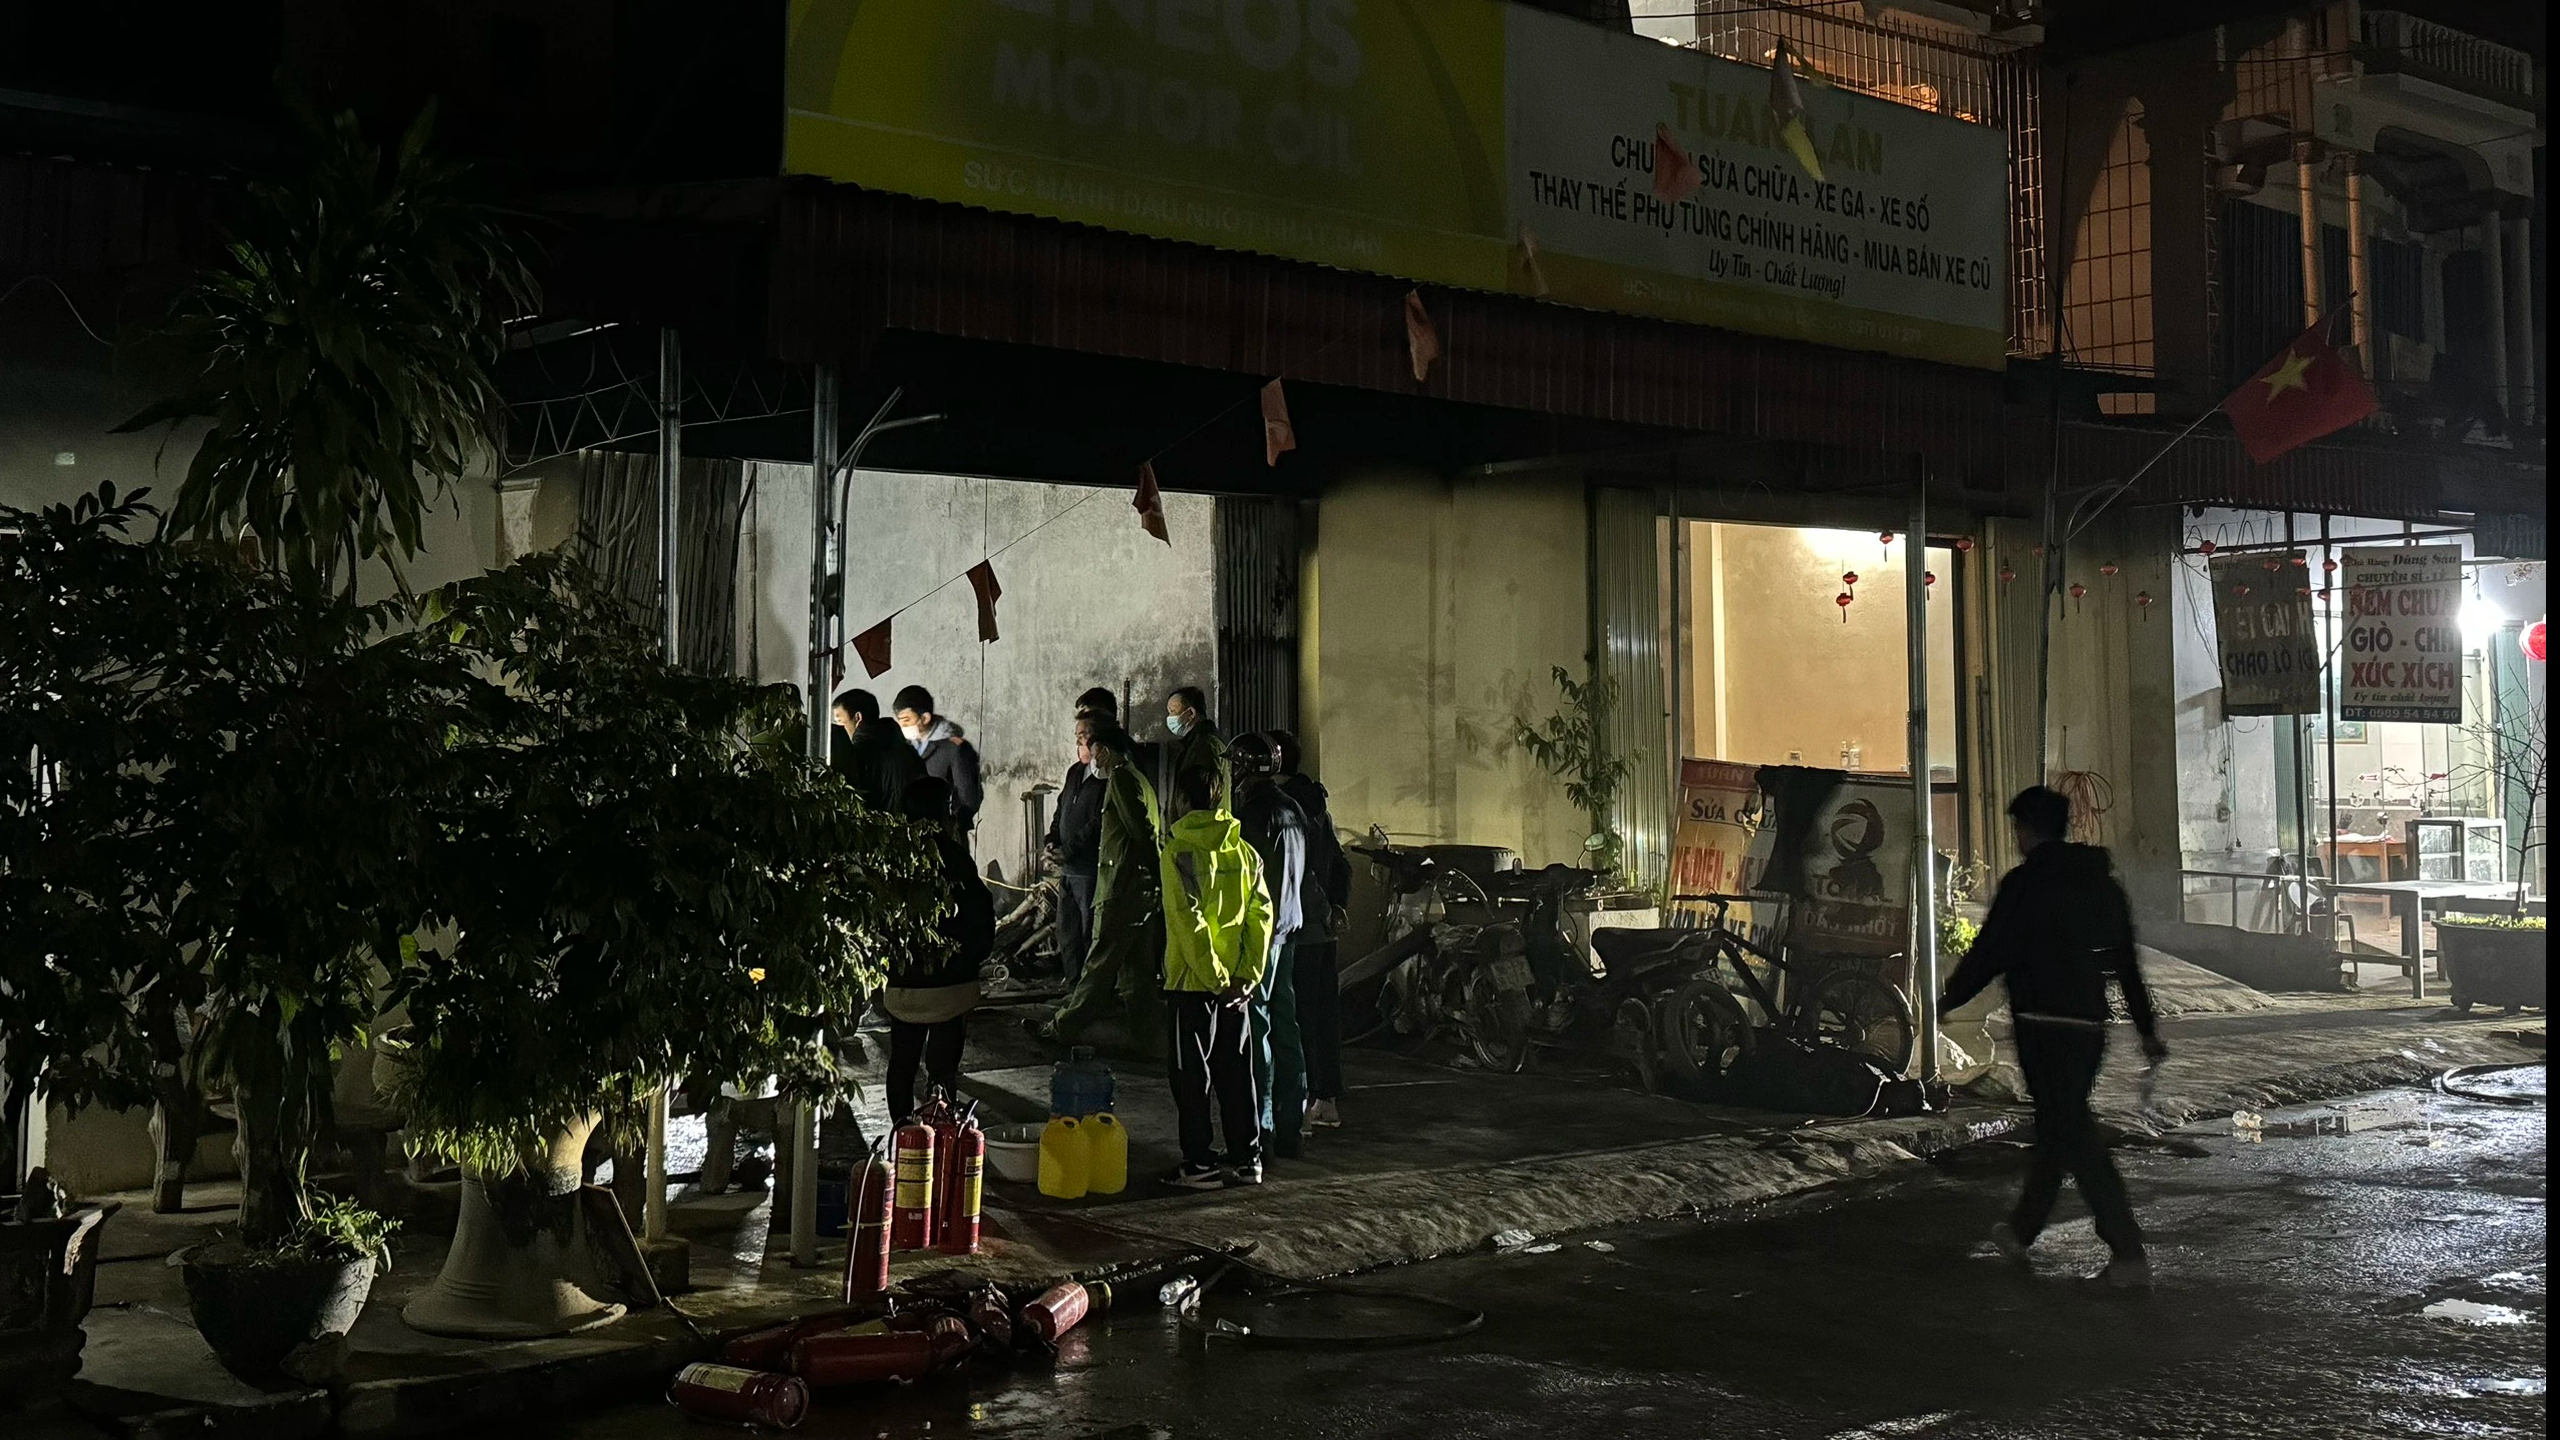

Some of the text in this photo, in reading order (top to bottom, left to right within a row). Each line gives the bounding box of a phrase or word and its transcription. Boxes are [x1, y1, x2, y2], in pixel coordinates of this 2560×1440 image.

[991, 40, 1364, 177] MOTOR OIL
[1699, 149, 1739, 192] SỬA
[1744, 164, 1800, 206] CHỮA
[1815, 181, 1836, 213] XE
[1841, 187, 1866, 220] GA
[1880, 197, 1903, 228] XE
[1905, 193, 1931, 233] SỐ
[1529, 171, 1583, 212] THAY
[1587, 178, 1627, 222] THẾ
[1633, 193, 1676, 238] PHỤ
[1680, 196, 1732, 242] TÙNG
[1737, 212, 1795, 256] CHÍNH
[1864, 243, 1903, 276] MUA
[1907, 244, 1942, 281] BÁN
[1945, 256, 1966, 286] XE
[1970, 255, 1992, 291] CŨ
[1764, 260, 1798, 287] Chất
[1801, 266, 1846, 300] Lượng!
[2356, 570, 2408, 583] CHUYÊN
[2351, 621, 2394, 653] GIÒ
[2350, 655, 2455, 690] XÚC XÍCH
[1691, 797, 1725, 821] SỬA
